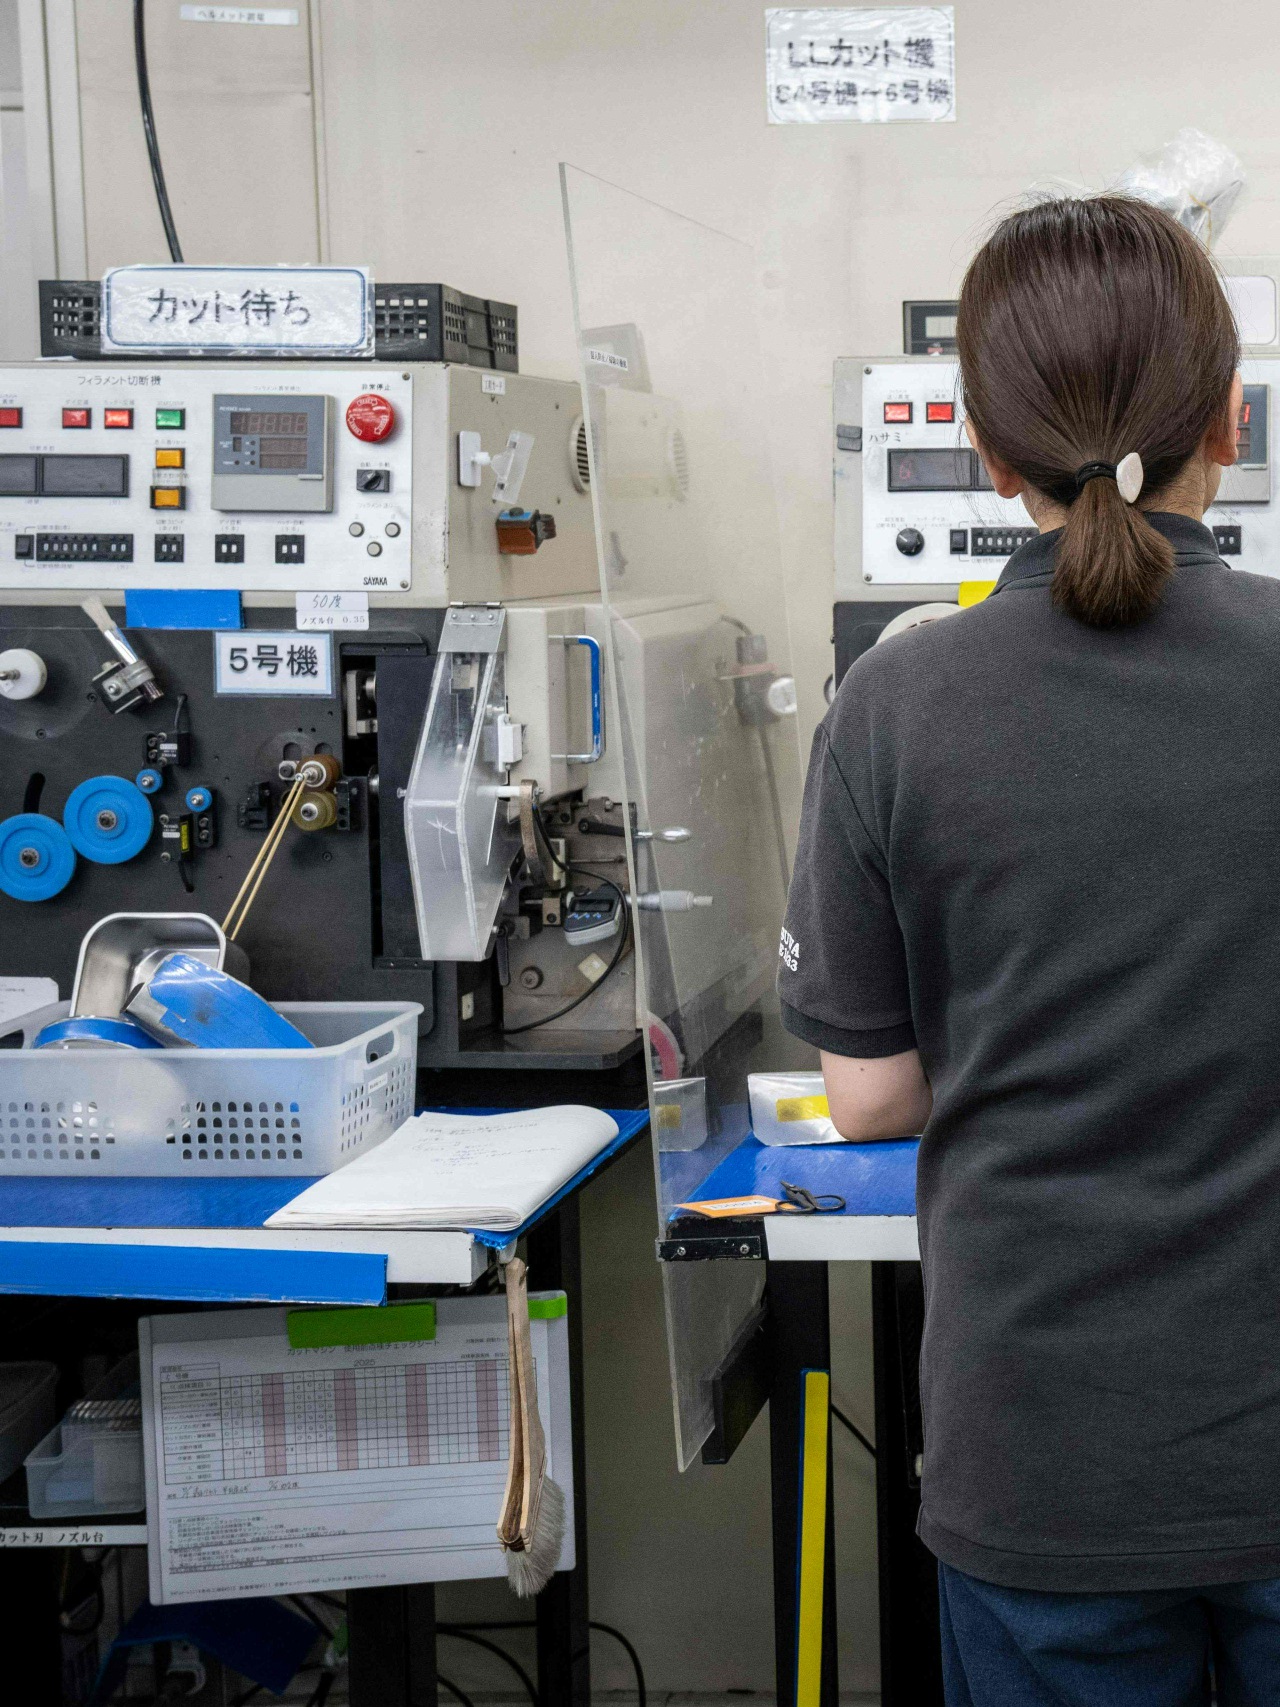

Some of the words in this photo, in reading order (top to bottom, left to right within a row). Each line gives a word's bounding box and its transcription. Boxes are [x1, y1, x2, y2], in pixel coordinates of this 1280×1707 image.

[147, 288, 311, 326] カット待ち
[77, 375, 162, 386] フィラメント切断機
[869, 431, 902, 443] ハサミ
[363, 577, 388, 586] SAYAKA
[342, 616, 366, 624] 0.35
[229, 643, 318, 677] 5号機
[353, 1359, 376, 1367] 2025
[57, 1532, 104, 1543] ノズル台
